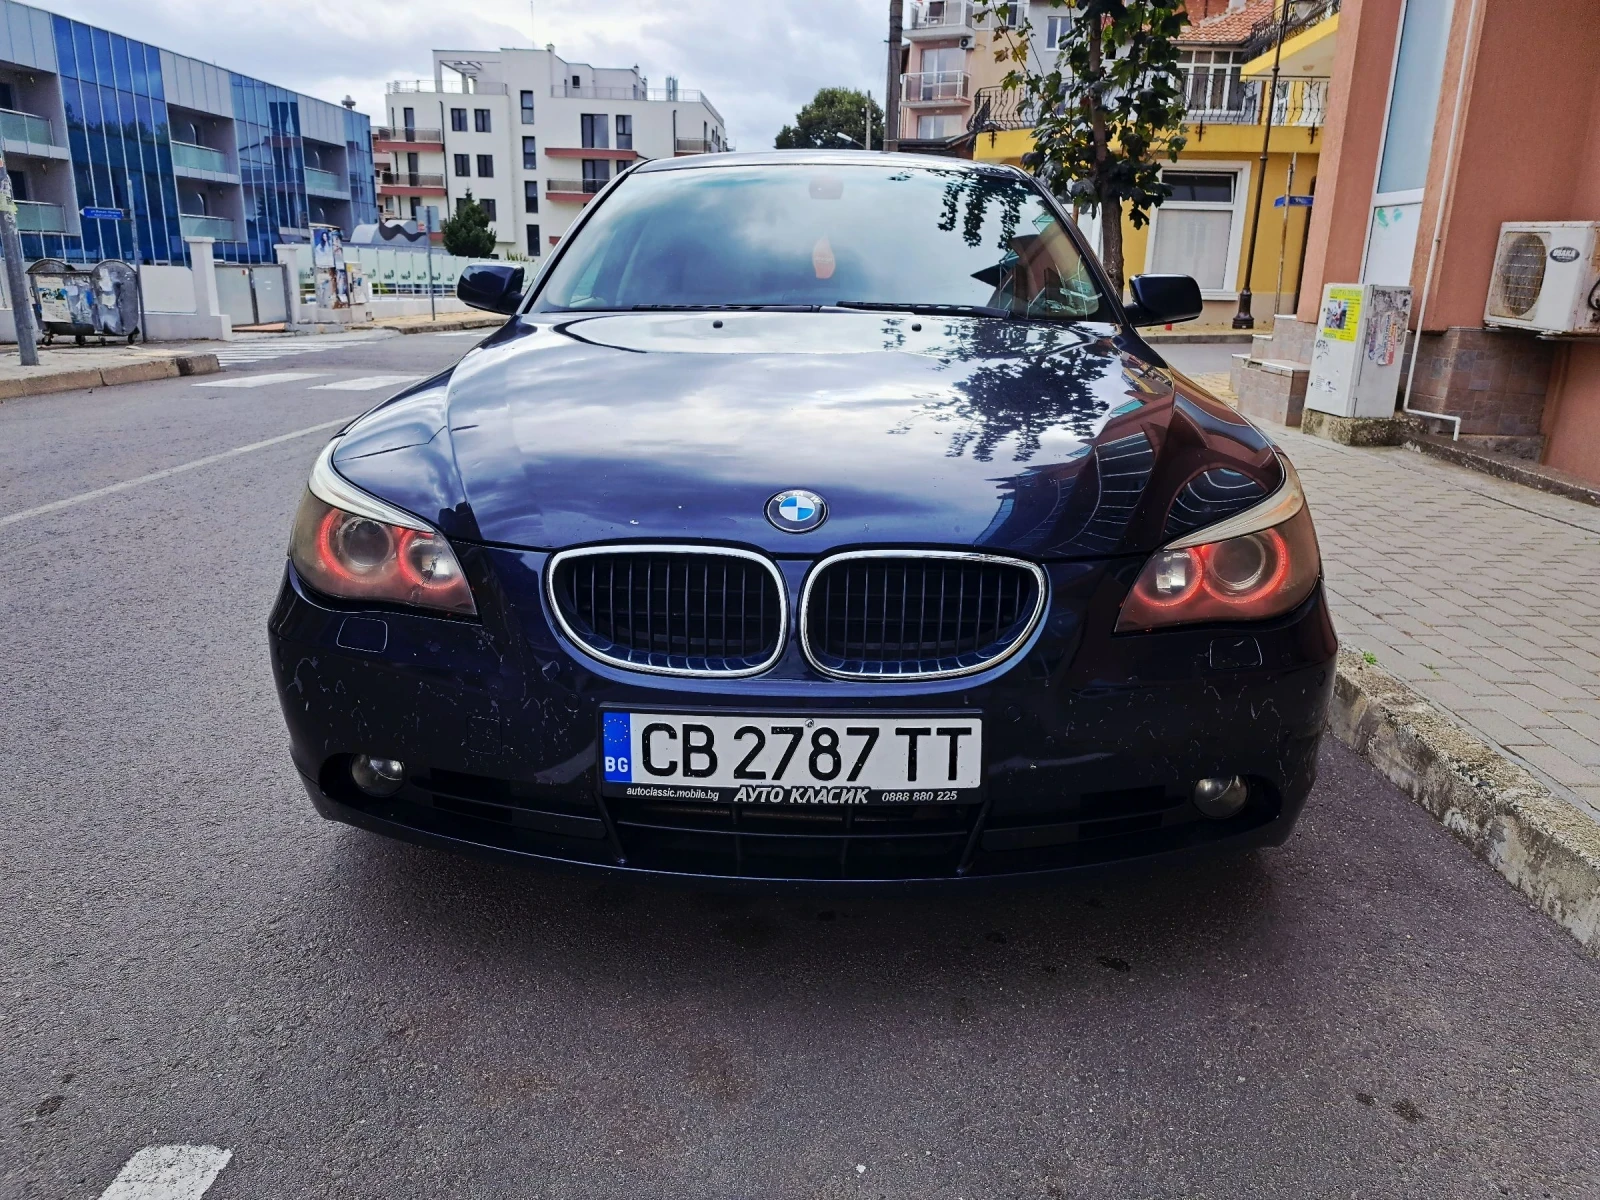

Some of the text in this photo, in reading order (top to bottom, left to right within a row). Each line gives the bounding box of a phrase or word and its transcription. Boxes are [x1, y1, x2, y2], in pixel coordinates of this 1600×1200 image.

[774, 491, 821, 503] BMW
[641, 722, 972, 782] CB 2787 TT
[604, 756, 629, 773] BG
[626, 786, 720, 802] autoclassic.mobile.bg
[881, 790, 958, 802] 0888 880 225
